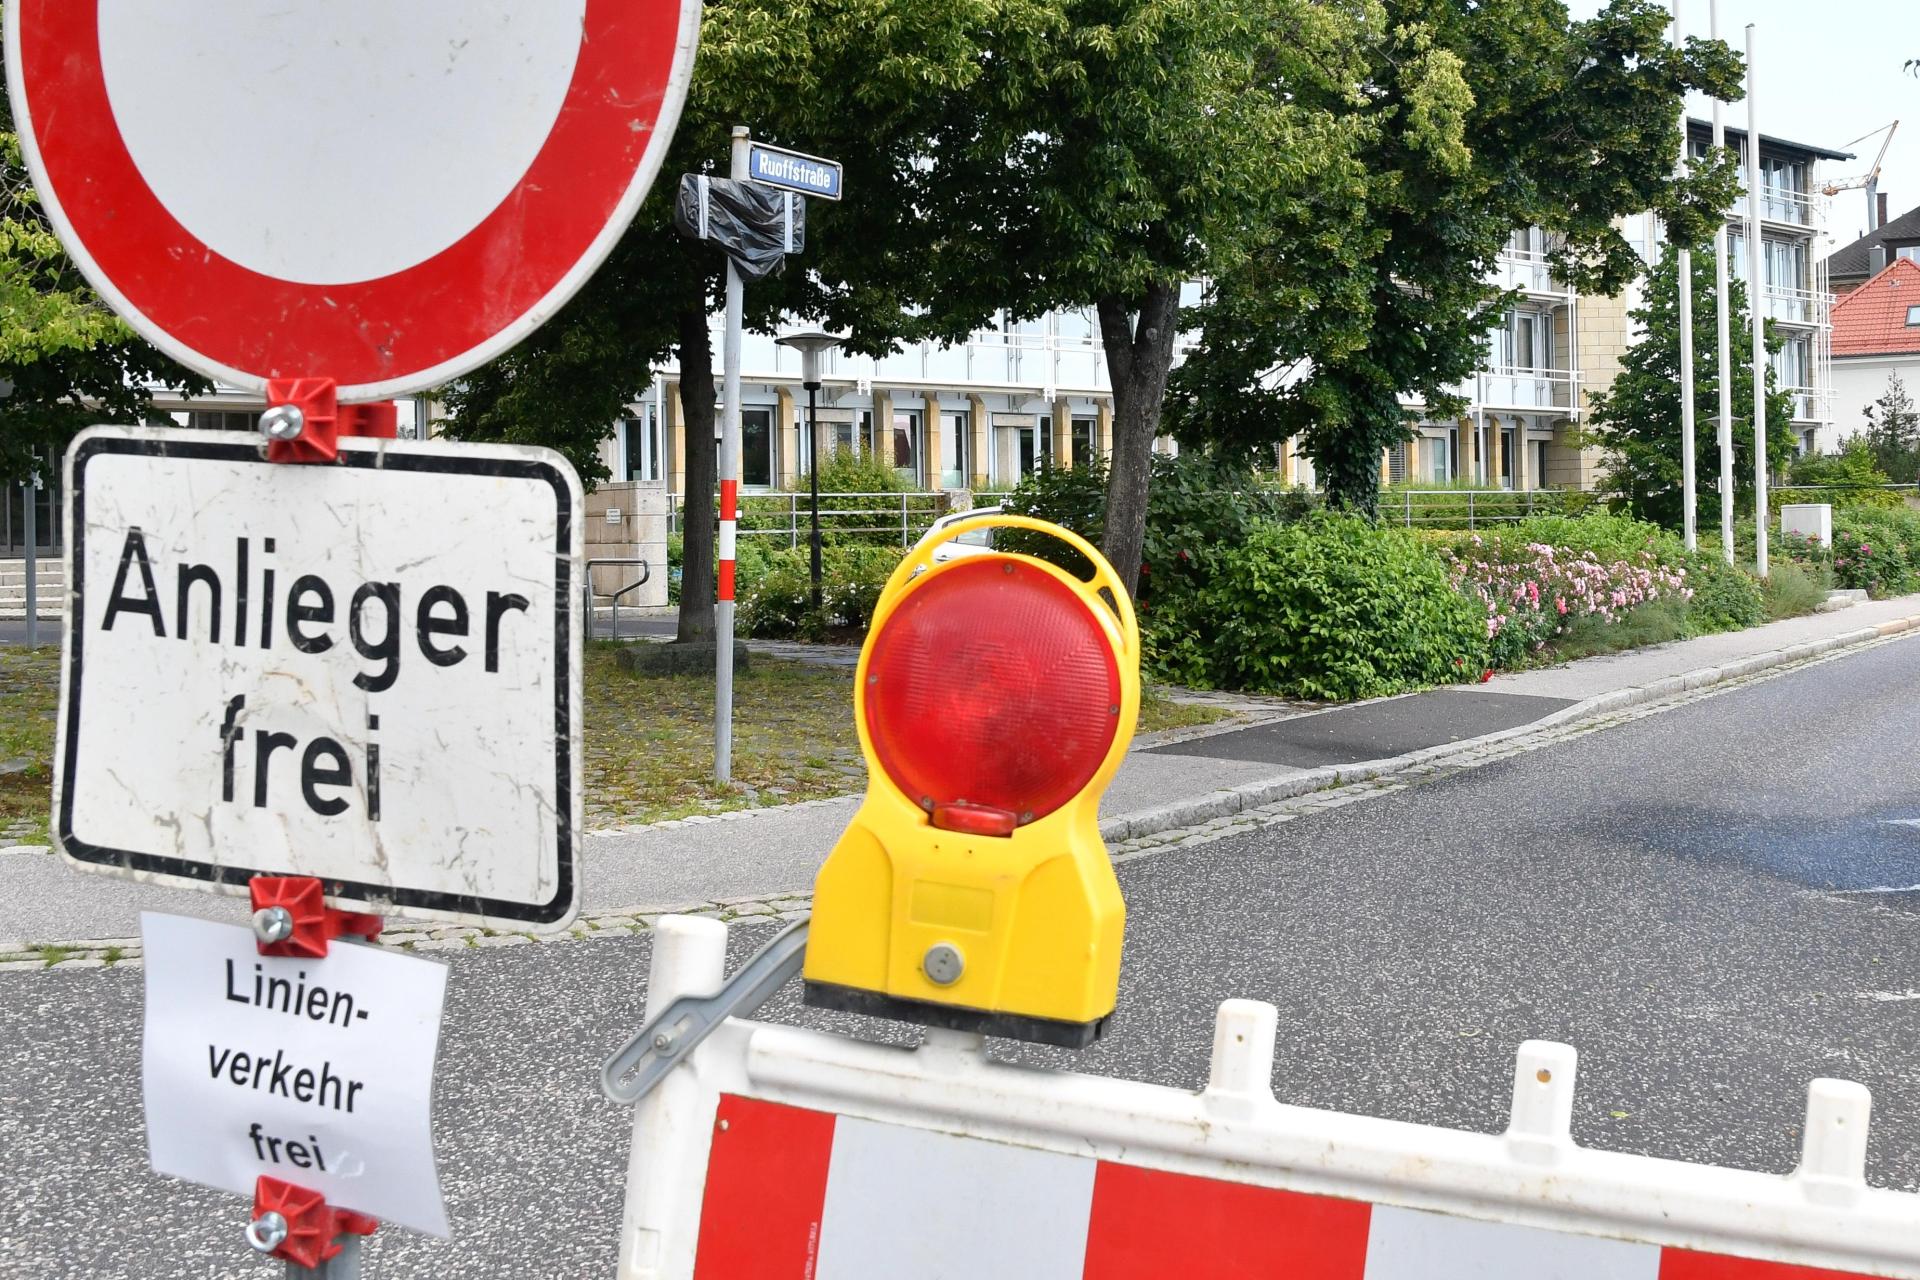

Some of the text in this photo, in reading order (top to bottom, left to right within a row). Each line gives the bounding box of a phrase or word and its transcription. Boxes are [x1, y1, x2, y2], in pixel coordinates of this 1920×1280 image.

[759, 153, 831, 189] Ruoffstraße
[101, 526, 530, 692] Anlieger
[220, 694, 381, 822] frei
[226, 958, 369, 1027] Linien-
[208, 1045, 363, 1113] verkehr
[249, 1123, 326, 1171] frei
